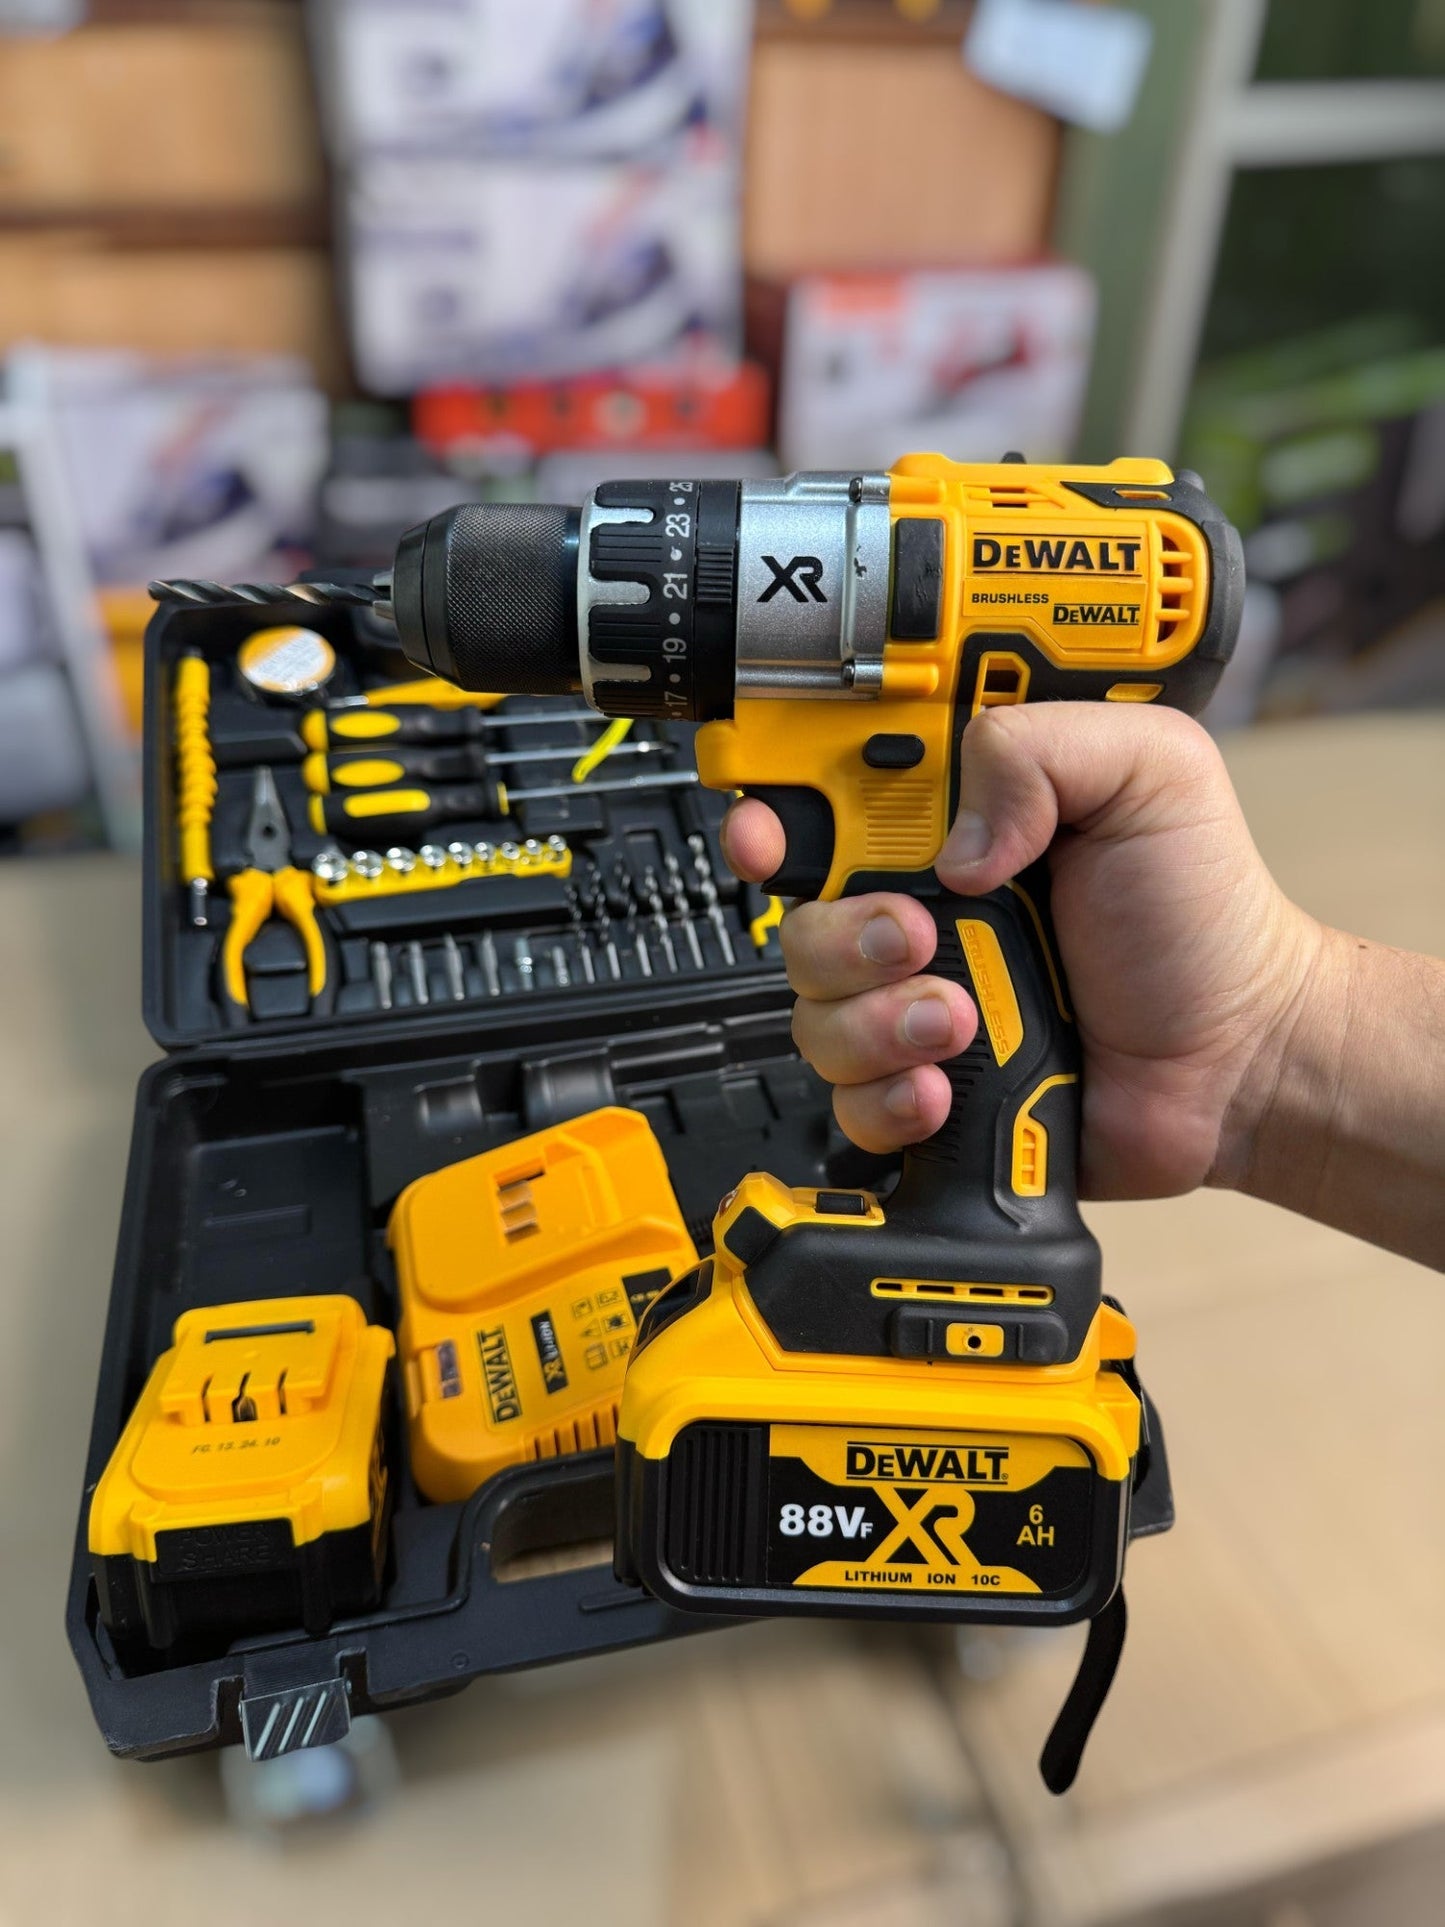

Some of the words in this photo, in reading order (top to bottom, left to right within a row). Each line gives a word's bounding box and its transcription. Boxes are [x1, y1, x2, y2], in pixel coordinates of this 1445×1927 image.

[665, 513, 691, 538] 23
[973, 539, 1141, 571] DEWALT
[663, 573, 688, 599] 21
[756, 555, 828, 602] XR
[972, 593, 1049, 604] BRUSHLESS
[1053, 606, 1140, 623] DEWALT
[663, 637, 687, 662] 19
[664, 691, 688, 707] 17
[963, 924, 1010, 1055] BRUSHLESS
[480, 1327, 522, 1423] DEWALT
[846, 1446, 1008, 1481] DEWALT
[865, 1484, 981, 1566] XR
[1029, 1504, 1043, 1525] 6
[1016, 1526, 1054, 1546] AH
[845, 1570, 912, 1584] LITHIUM
[928, 1573, 956, 1585] ION
[971, 1574, 1001, 1586] 10C
